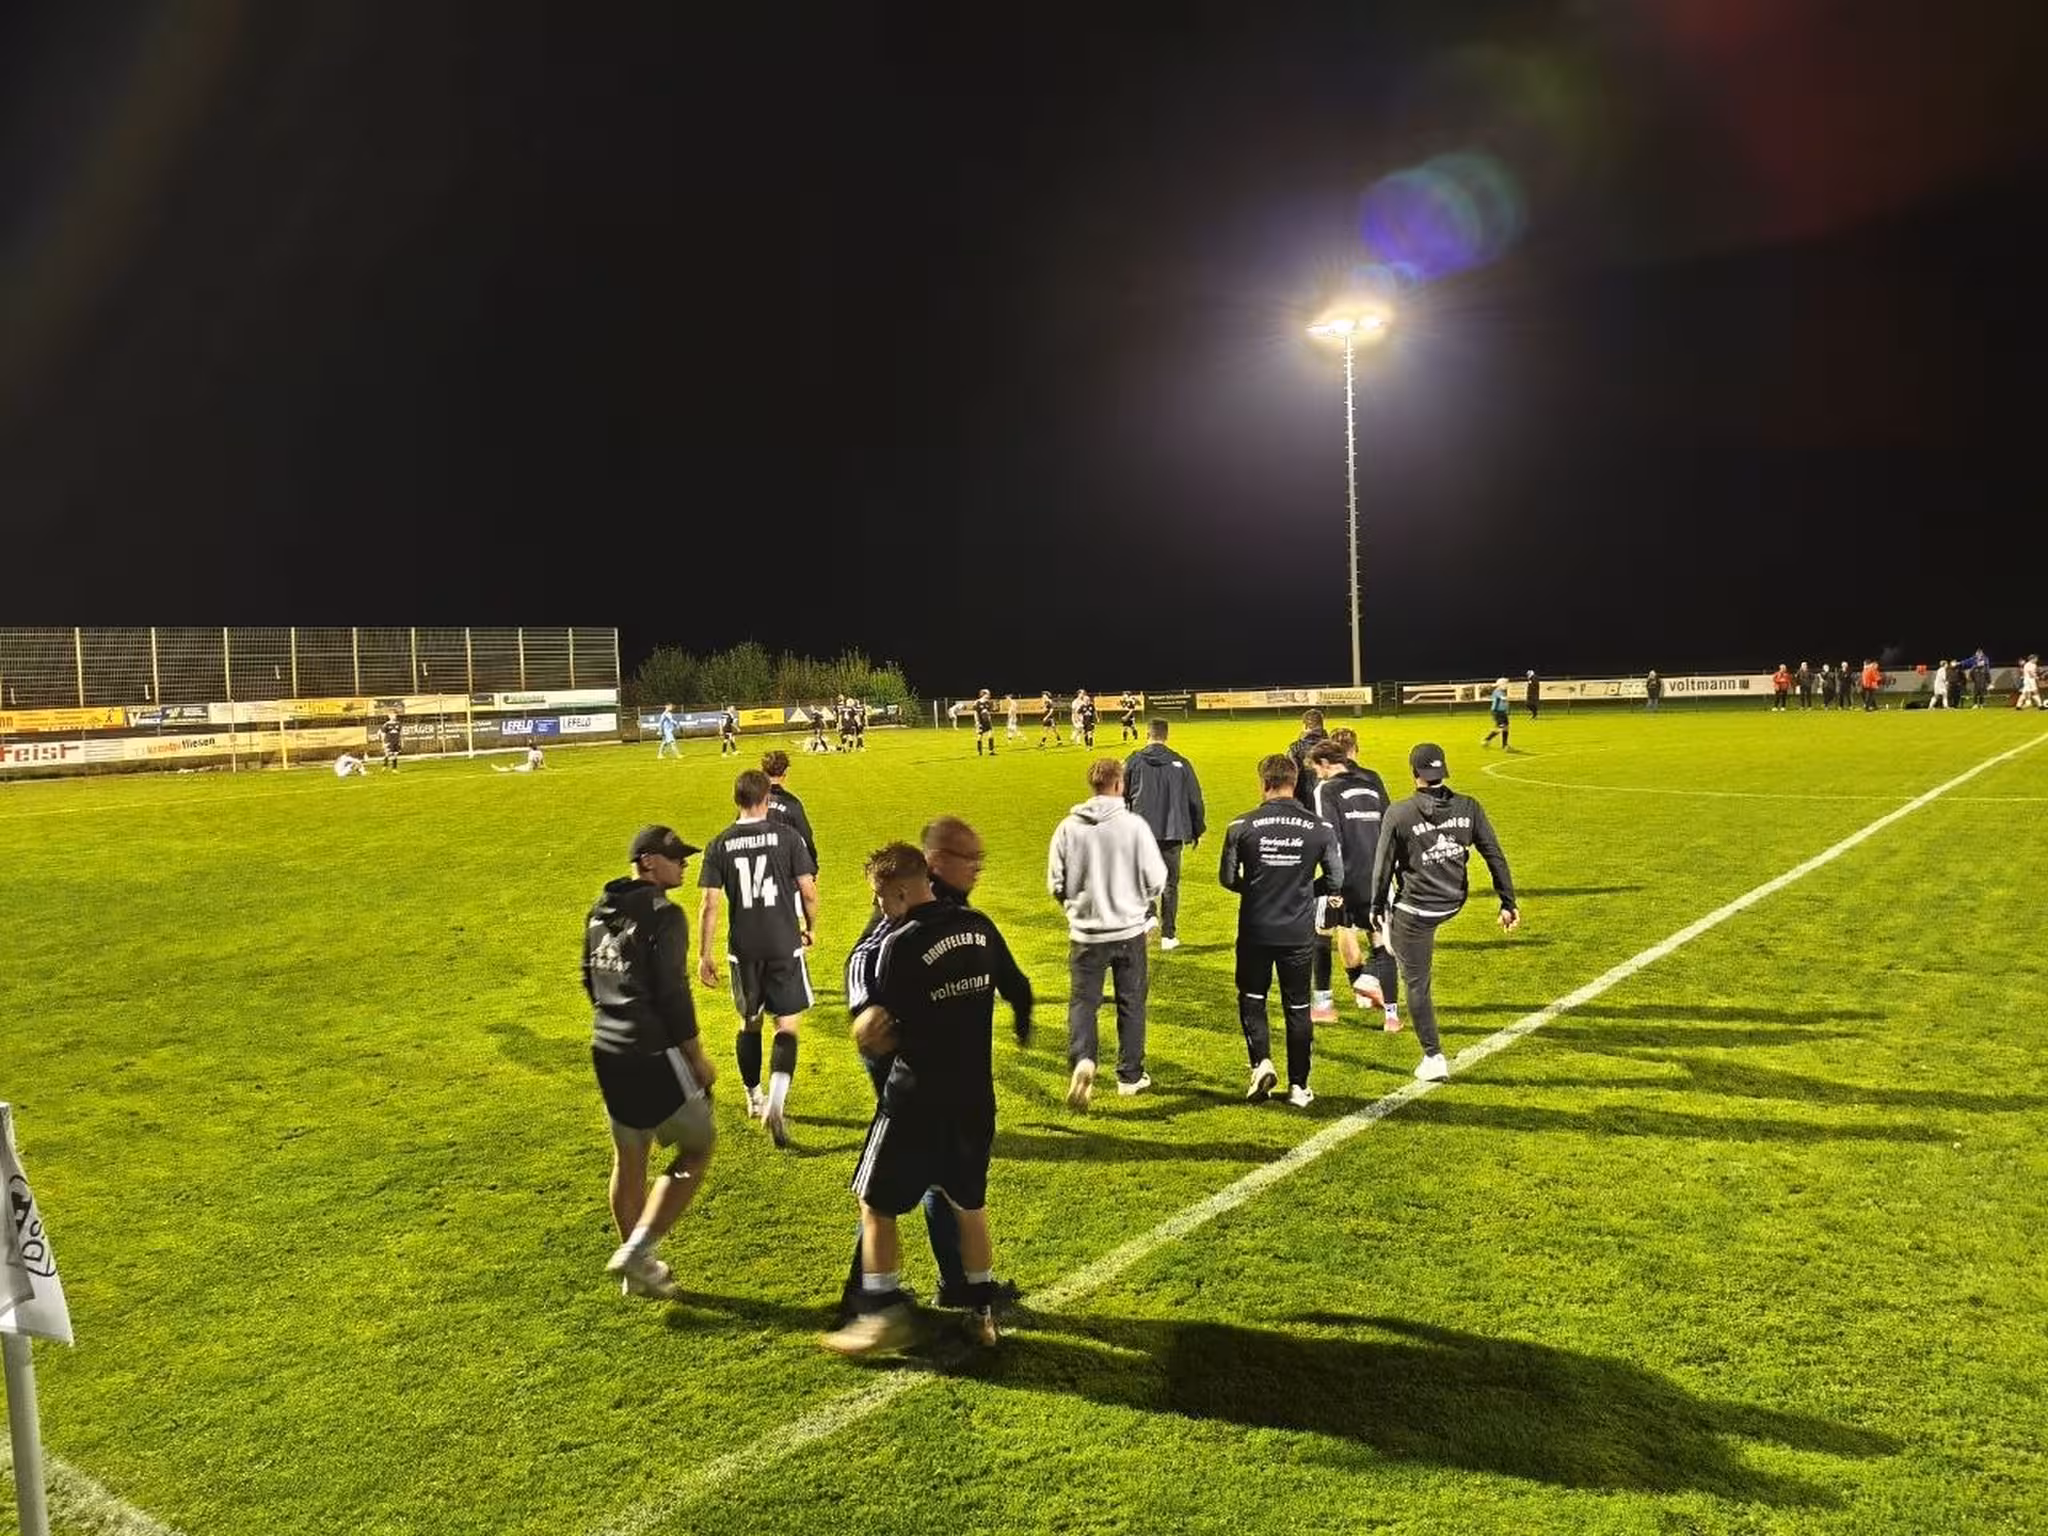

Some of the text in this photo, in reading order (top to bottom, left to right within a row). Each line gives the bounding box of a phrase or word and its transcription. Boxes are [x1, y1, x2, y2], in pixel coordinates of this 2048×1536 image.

[1669, 678, 1737, 692] voltmann
[502, 720, 533, 732] LEFELD
[563, 718, 591, 729] LEFELD
[734, 854, 778, 908] 14
[921, 932, 987, 966] DRUFFELER SG
